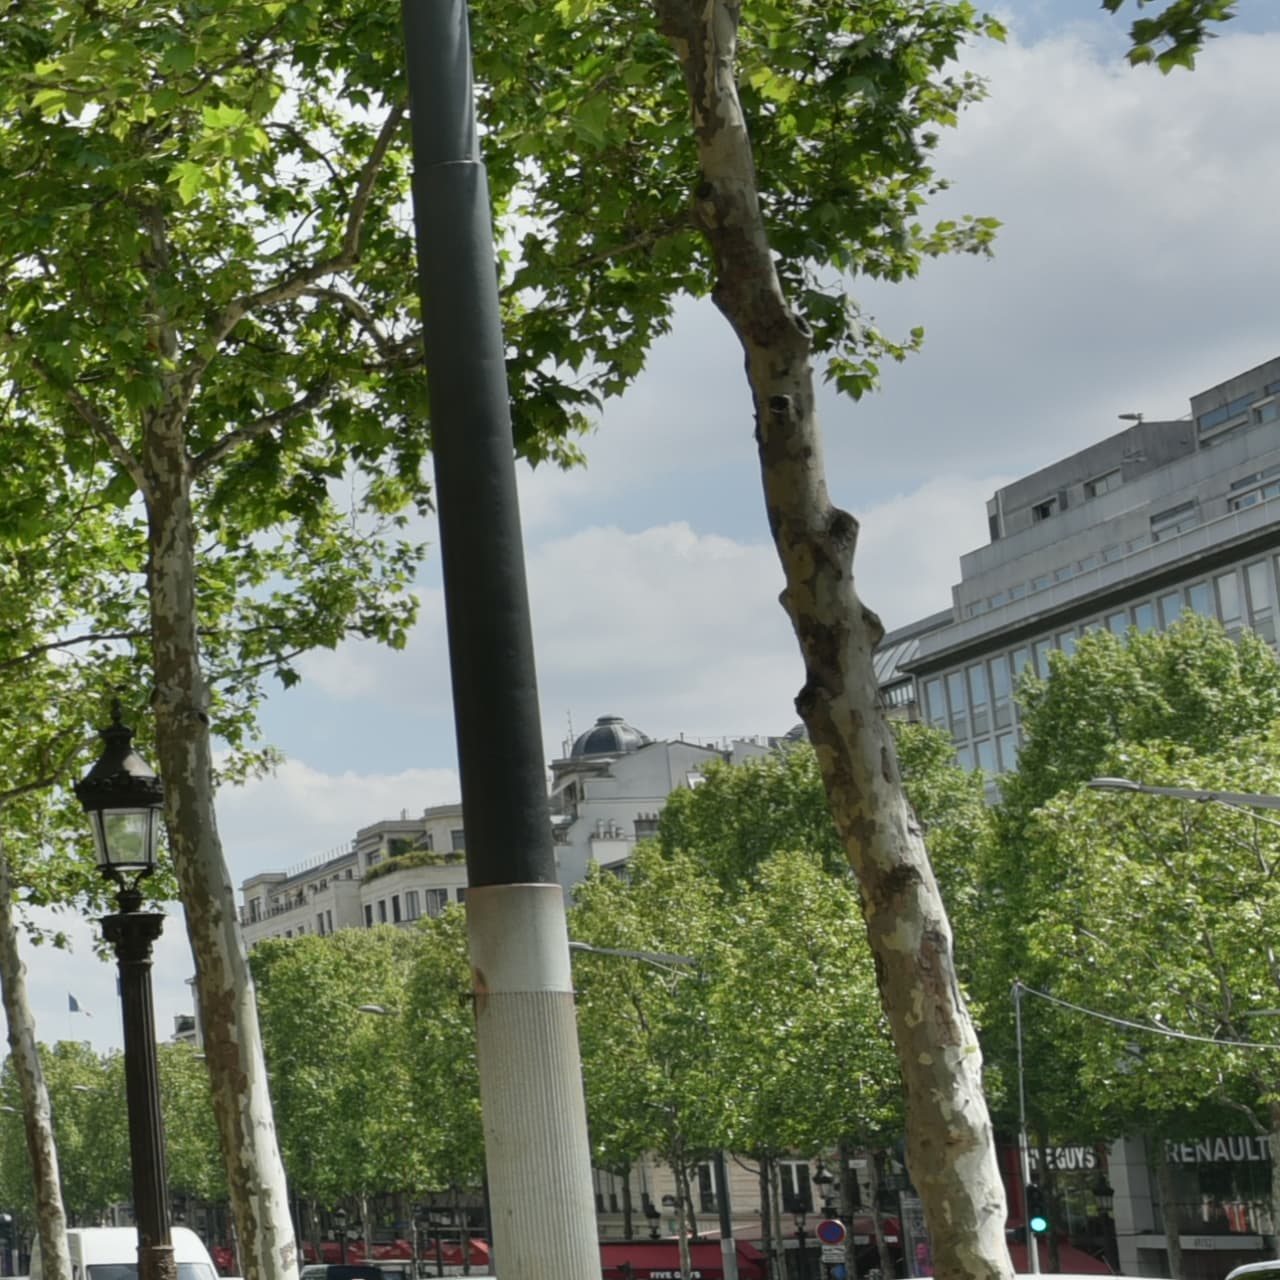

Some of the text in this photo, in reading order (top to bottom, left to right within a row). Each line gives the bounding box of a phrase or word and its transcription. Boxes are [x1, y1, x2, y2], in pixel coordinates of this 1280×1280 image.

[1056, 1146, 1096, 1170] GUYS
[1165, 1136, 1270, 1163] RENAULT
[650, 1271, 672, 1279] FIVE
